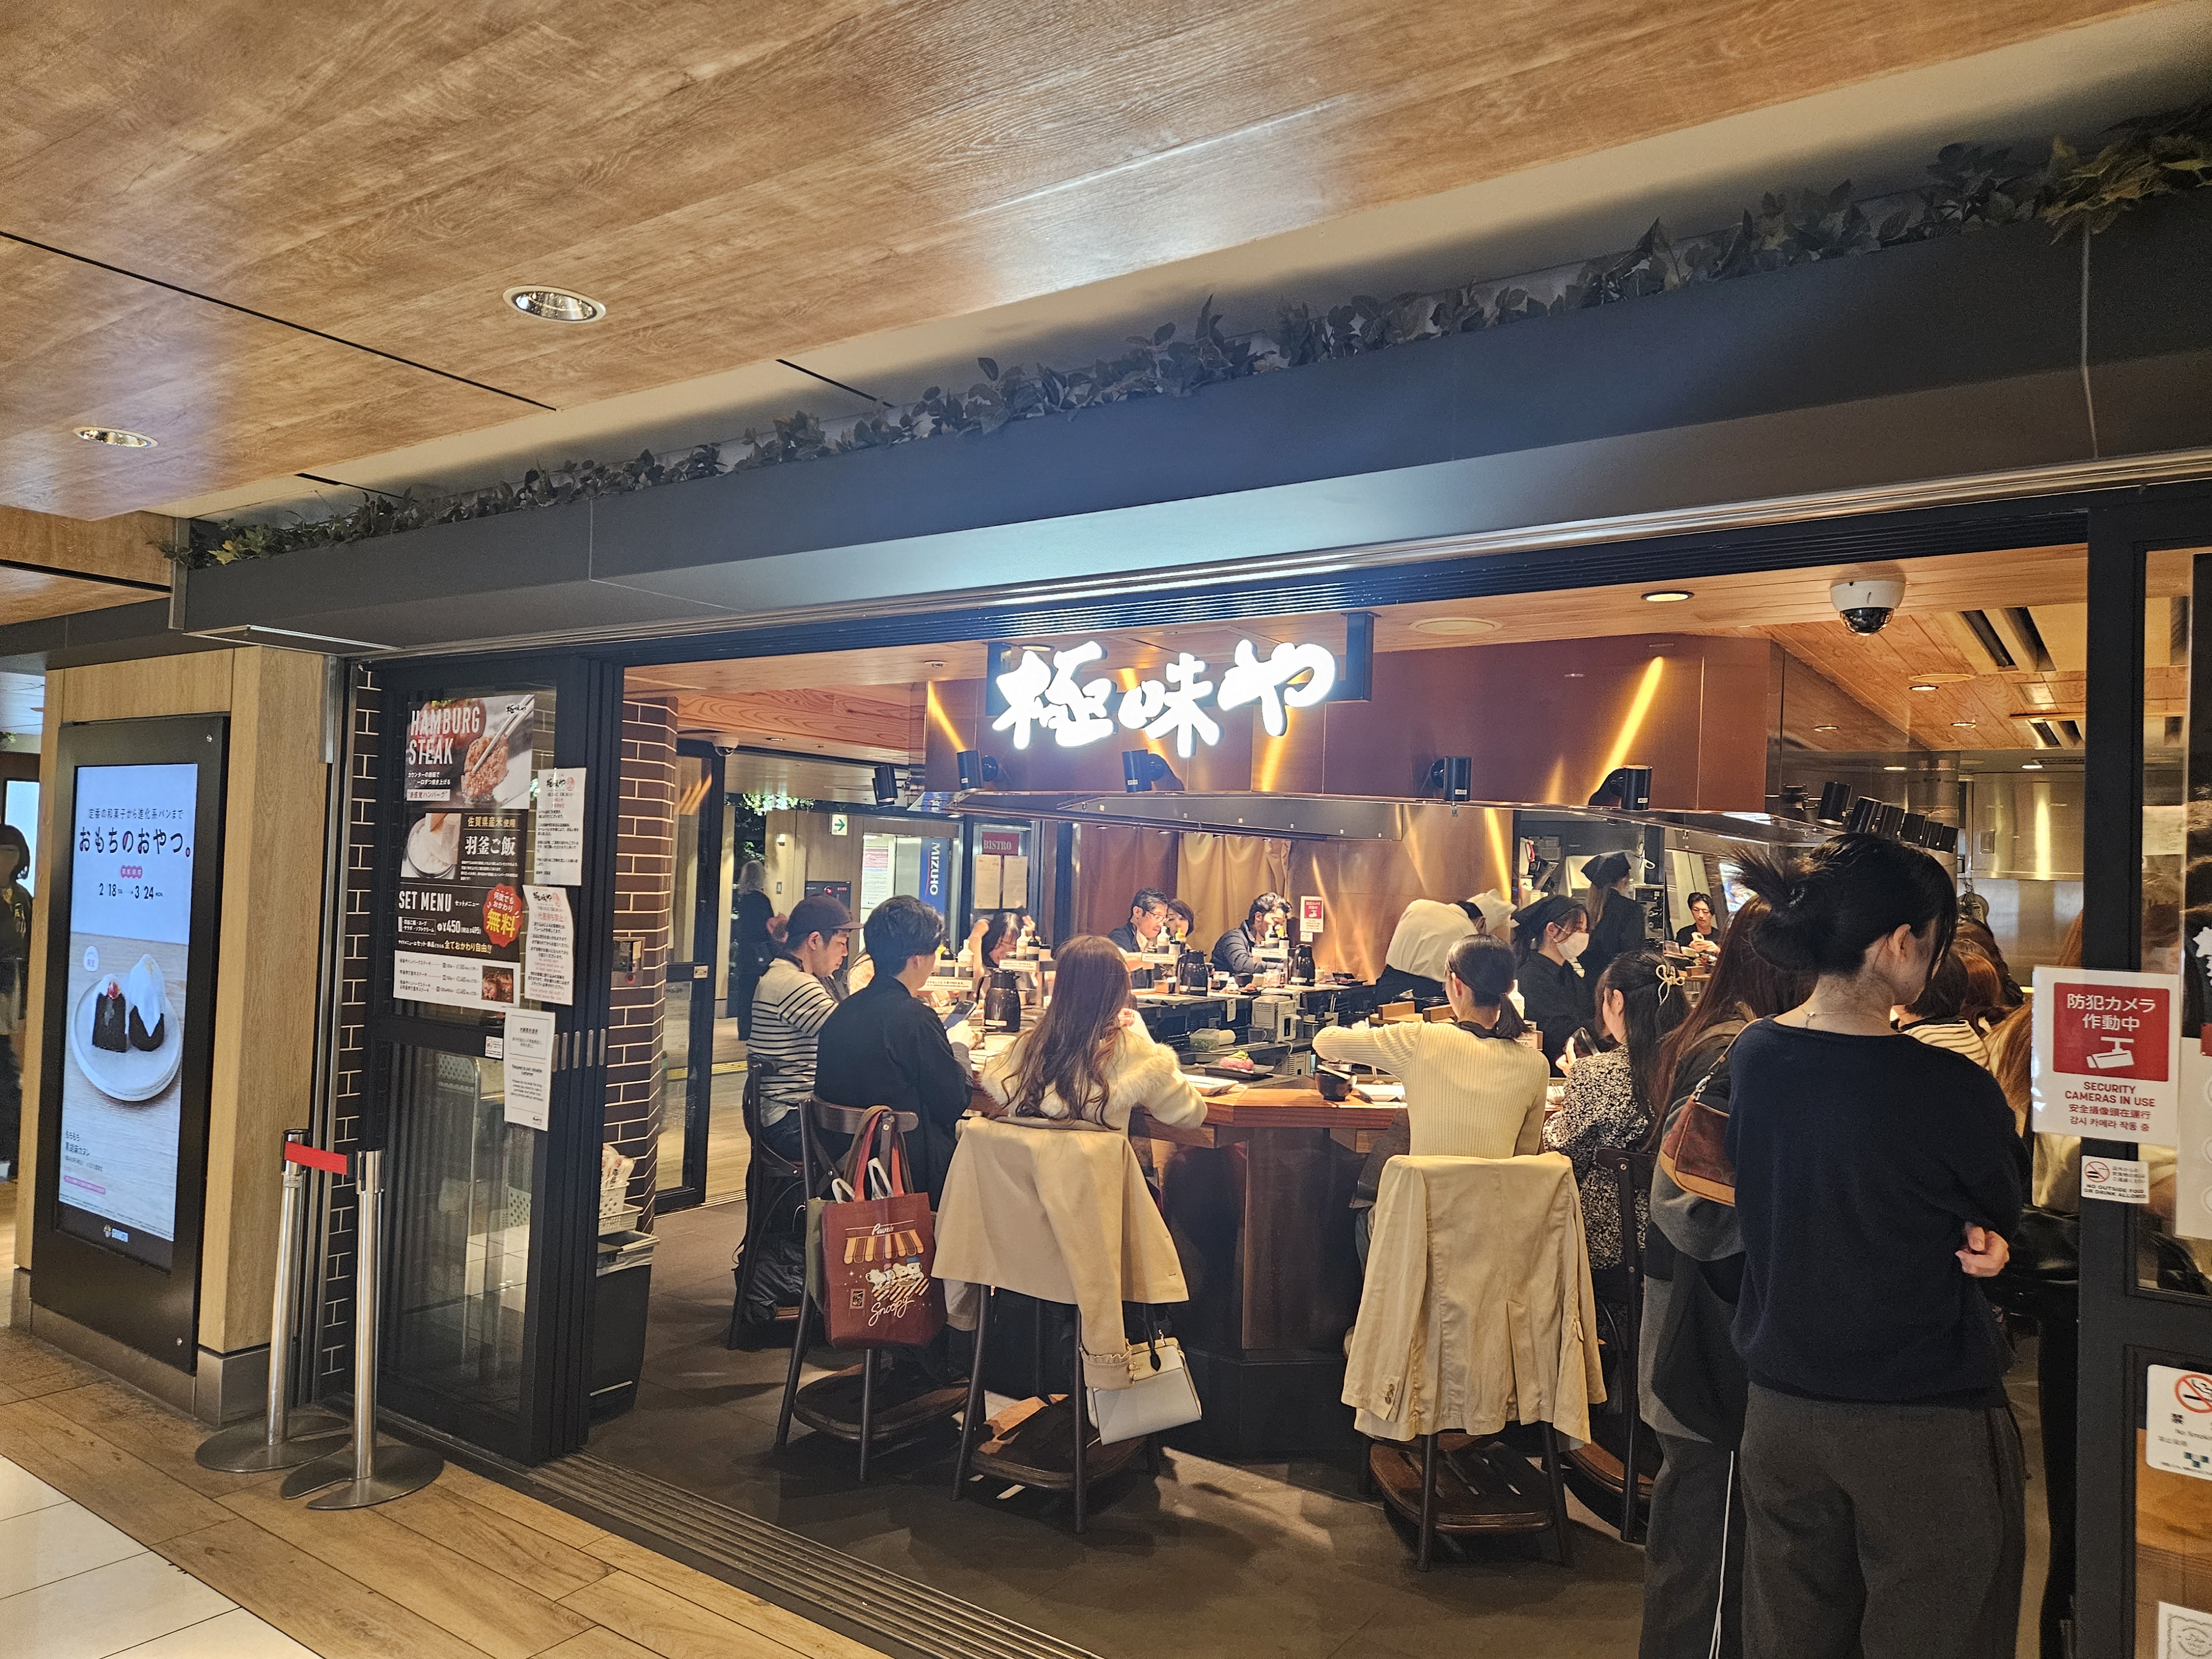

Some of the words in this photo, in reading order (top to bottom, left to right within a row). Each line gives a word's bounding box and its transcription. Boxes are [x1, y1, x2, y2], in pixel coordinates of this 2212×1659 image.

[992, 639, 1335, 758] 極味や
[410, 706, 480, 736] HAMBURG
[409, 738, 453, 765] STEAK
[89, 808, 184, 820] 定番の和菓子から進化系パンまで
[468, 816, 516, 827] 佐賀県産米使用
[80, 827, 191, 857] おもちのおやつ。
[465, 836, 516, 855] 羽釜ご飯
[983, 839, 1012, 850] BISTRO
[930, 842, 940, 895] MIZUHO
[399, 891, 418, 910] SET
[421, 891, 452, 912] MENU
[493, 891, 514, 904] 何度でも
[493, 901, 513, 912] おかわり
[486, 909, 517, 938] 無料
[2067, 994, 2156, 1013] 防犯カメラ
[2083, 1013, 2140, 1031] 作動中
[2084, 1082, 2136, 1094] SECURITY
[2065, 1091, 2116, 1103] CAMERAS
[2120, 1096, 2130, 1105] IN
[2135, 1098, 2155, 1107] USE
[2070, 1116, 2087, 1126] 감시
[2090, 1118, 2117, 1129] 카메라
[2120, 1121, 2137, 1130] 작동
[2141, 1123, 2150, 1131] 중
[868, 1296, 914, 1326] Snoopy
